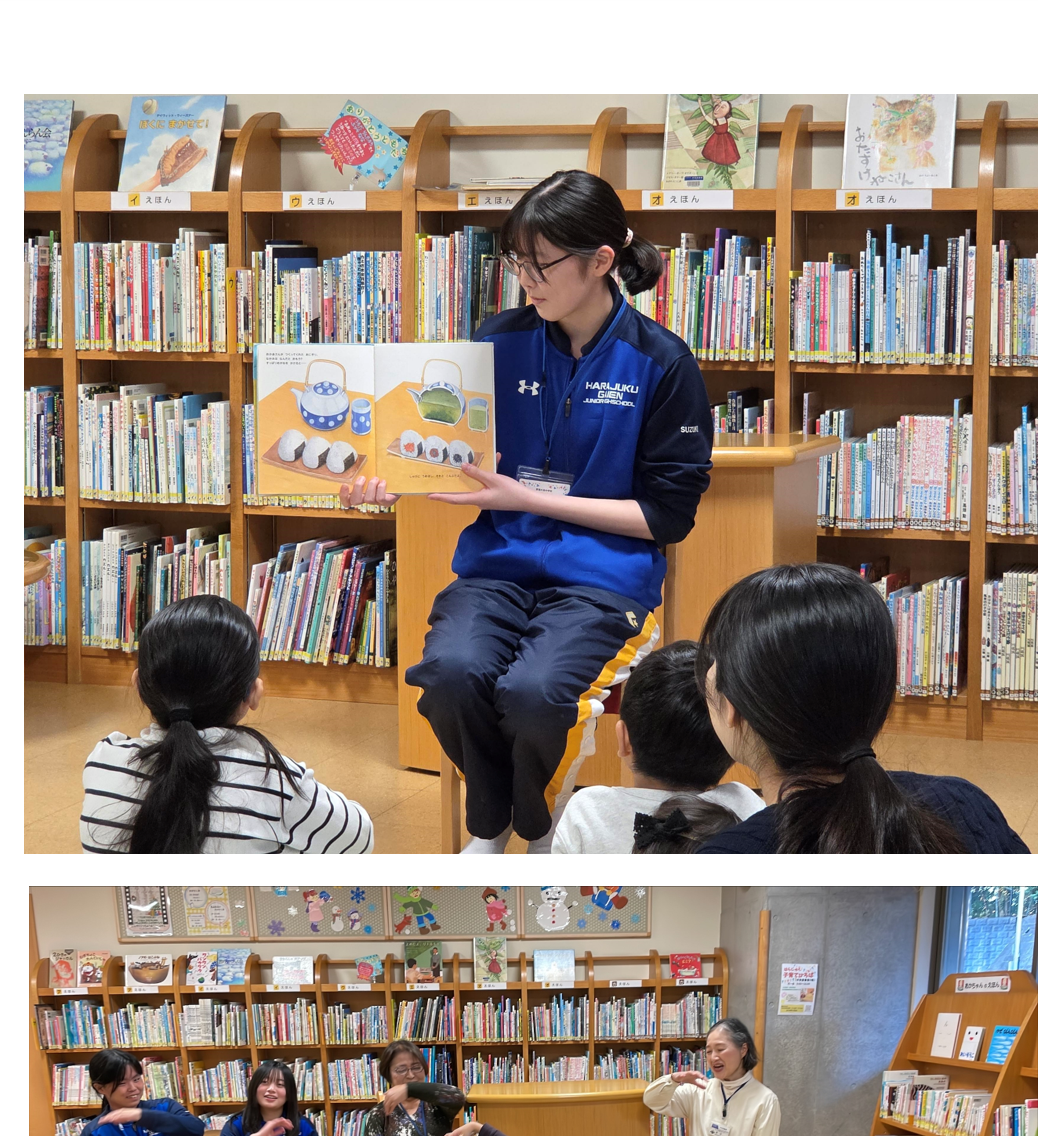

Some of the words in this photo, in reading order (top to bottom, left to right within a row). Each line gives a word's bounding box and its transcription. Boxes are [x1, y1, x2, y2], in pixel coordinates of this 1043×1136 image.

[139, 119, 165, 129] ぼくに
[145, 196, 172, 204] えほん
[291, 196, 301, 207] ウ
[307, 196, 335, 206] えほん
[467, 196, 477, 207] エ
[484, 196, 513, 205] えほん
[669, 195, 700, 204] えほん
[865, 195, 897, 204] えほん
[680, 425, 699, 434] SUZUKI
